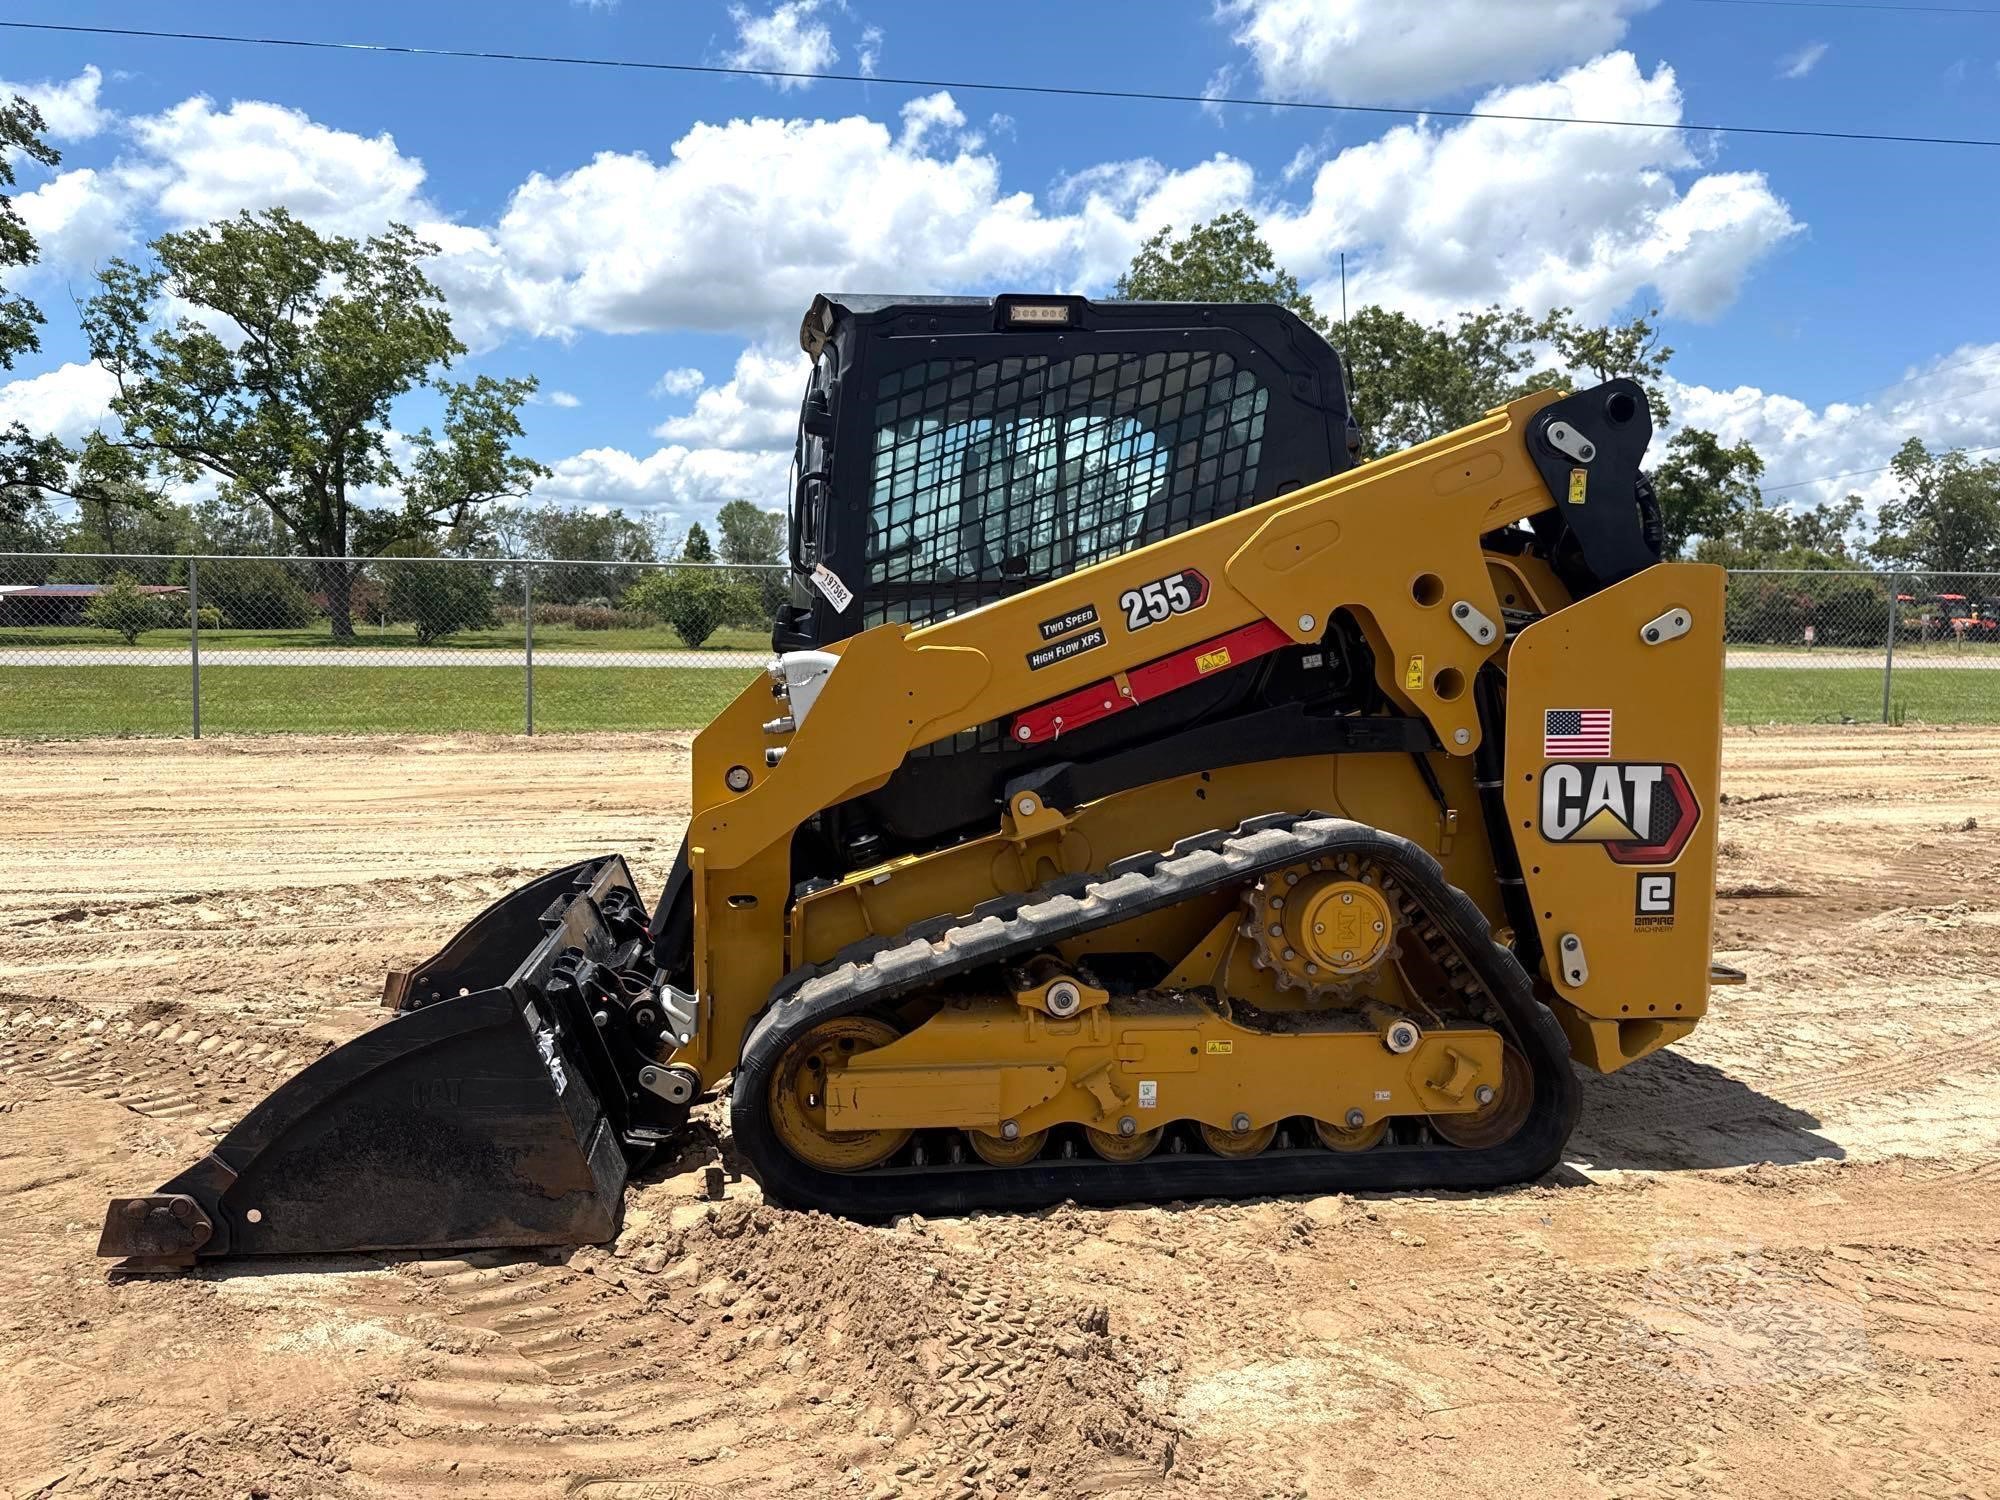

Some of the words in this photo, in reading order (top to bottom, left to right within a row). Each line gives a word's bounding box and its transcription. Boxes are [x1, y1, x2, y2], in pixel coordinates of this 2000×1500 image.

[824, 573, 848, 603] 197562
[1121, 573, 1192, 631] 255
[1043, 621, 1064, 636] TWO
[1065, 609, 1093, 629] SPEED
[1032, 651, 1054, 667] HIGH
[1056, 641, 1079, 658] FLOW
[1081, 632, 1101, 648] XPS
[1542, 764, 1662, 840] CAT
